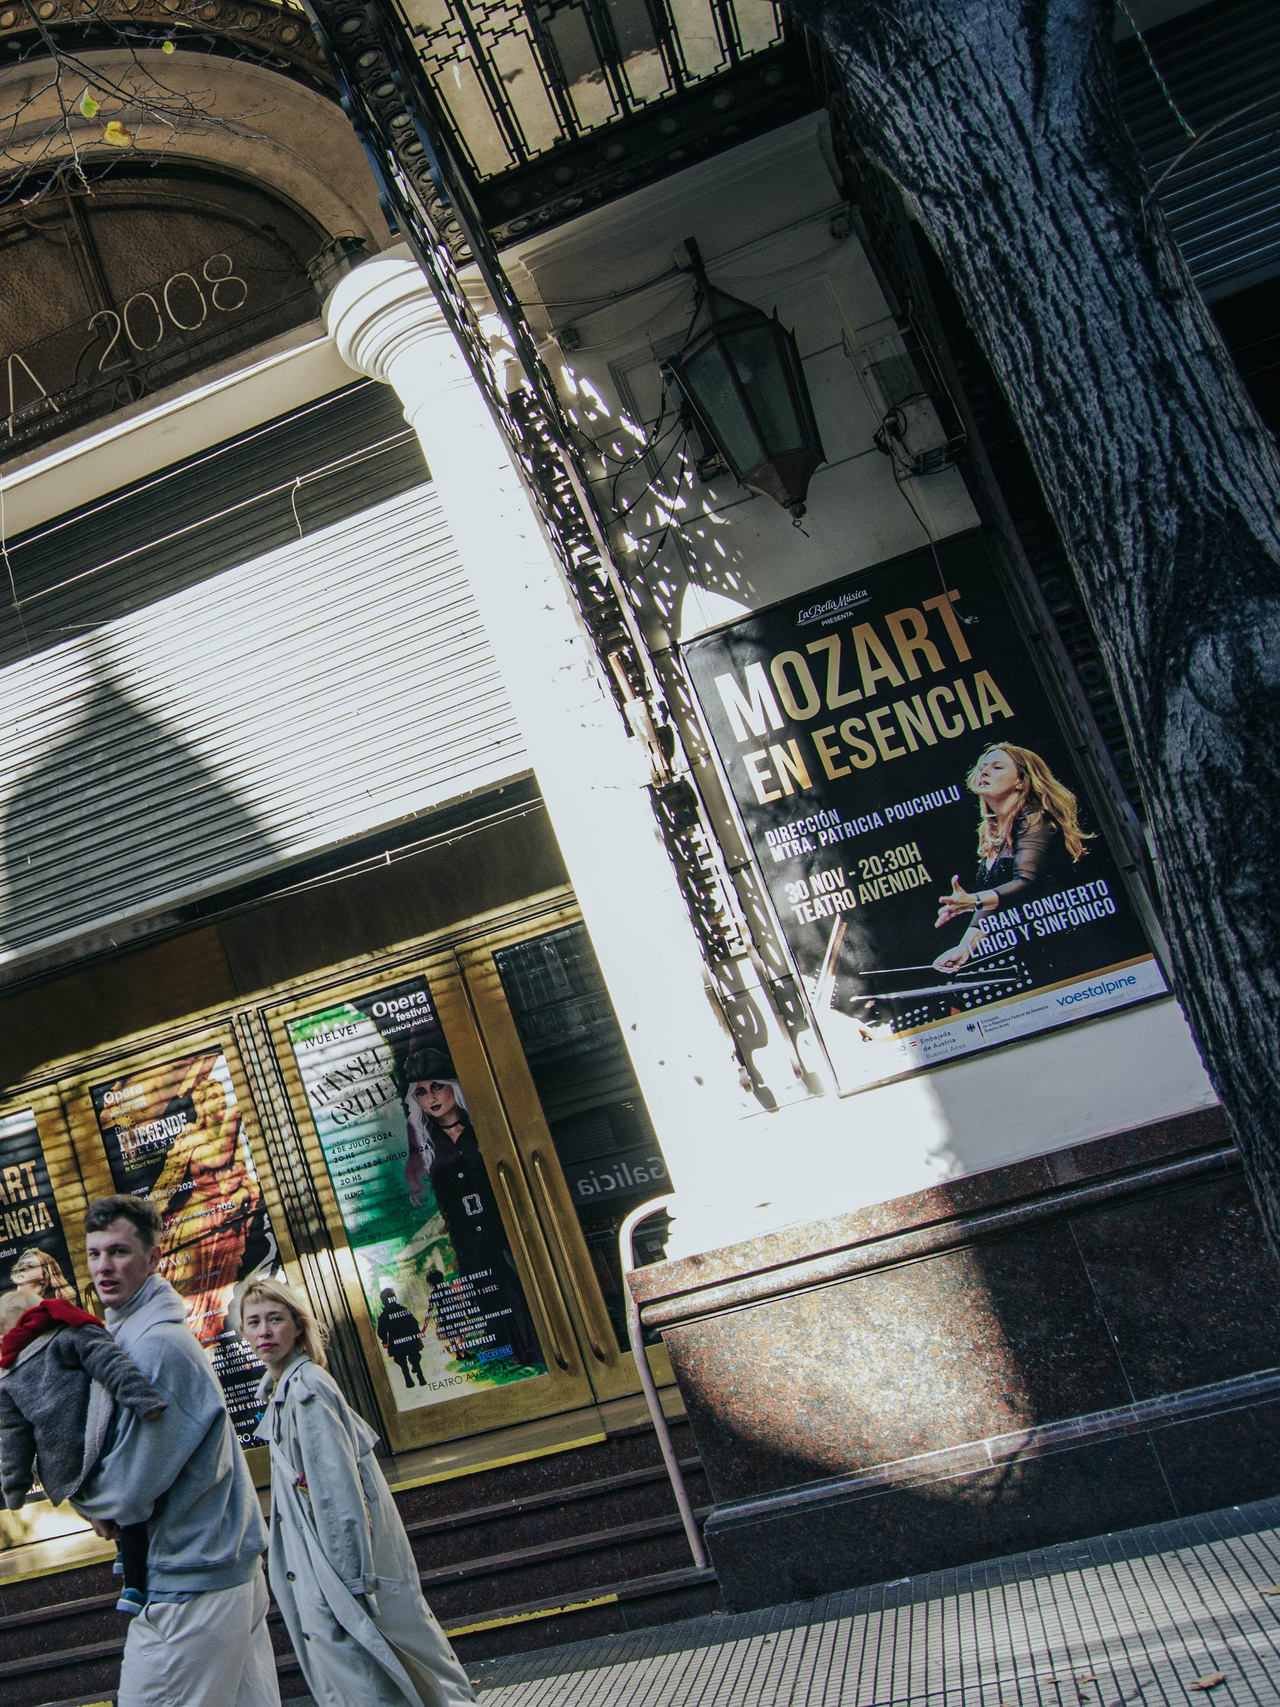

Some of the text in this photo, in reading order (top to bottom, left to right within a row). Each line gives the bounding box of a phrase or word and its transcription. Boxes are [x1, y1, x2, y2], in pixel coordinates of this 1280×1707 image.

[87, 253, 248, 372] 2008
[821, 611, 854, 627] PRESENTA
[714, 588, 972, 743] MOZART
[742, 669, 1015, 806] EN ESENCIA
[764, 808, 841, 847] DIRECCIÓN
[770, 785, 961, 863] MTRA. PATRICIA POUCHULU
[785, 842, 922, 904] 30 NOV 20:30H
[791, 864, 932, 925] TEATRO AVENIDA
[978, 879, 1110, 935] GRAN CONCIERTO
[970, 897, 1116, 958] LÍRICO Y SINFÓNICO
[372, 990, 428, 1018] Opera
[1056, 975, 1137, 1007] voestalpine
[381, 1014, 434, 1036] BUENOS AIRES
[395, 1004, 431, 1022] festival
[305, 1023, 358, 1049] ¡VUELVE!
[920, 1030, 951, 1045] Embajada
[933, 1037, 957, 1050] Austria
[926, 1043, 967, 1060] Buenos Aires
[103, 1084, 143, 1104] Opera
[116, 1112, 191, 1153] FLIEGENDE
[333, 1152, 356, 1164] 20 HS
[337, 1145, 347, 1154] DE
[349, 1139, 370, 1150] JULIO
[373, 1158, 383, 1167] DE
[384, 1151, 407, 1163] JULIO
[144, 1194, 153, 1203] de
[155, 1187, 176, 1201] Mayo
[178, 1179, 198, 1192] 2024
[340, 1174, 362, 1186] 20 HS
[344, 1189, 365, 1200] ELENCO
[170, 1218, 181, 1227] 25
[193, 1208, 215, 1221] Mayo
[216, 1200, 237, 1213] 2024
[449, 1334, 497, 1353] DE GYLDENFELDT
[427, 1375, 463, 1392] TEATRO
[465, 1366, 510, 1382] AVENIDA
